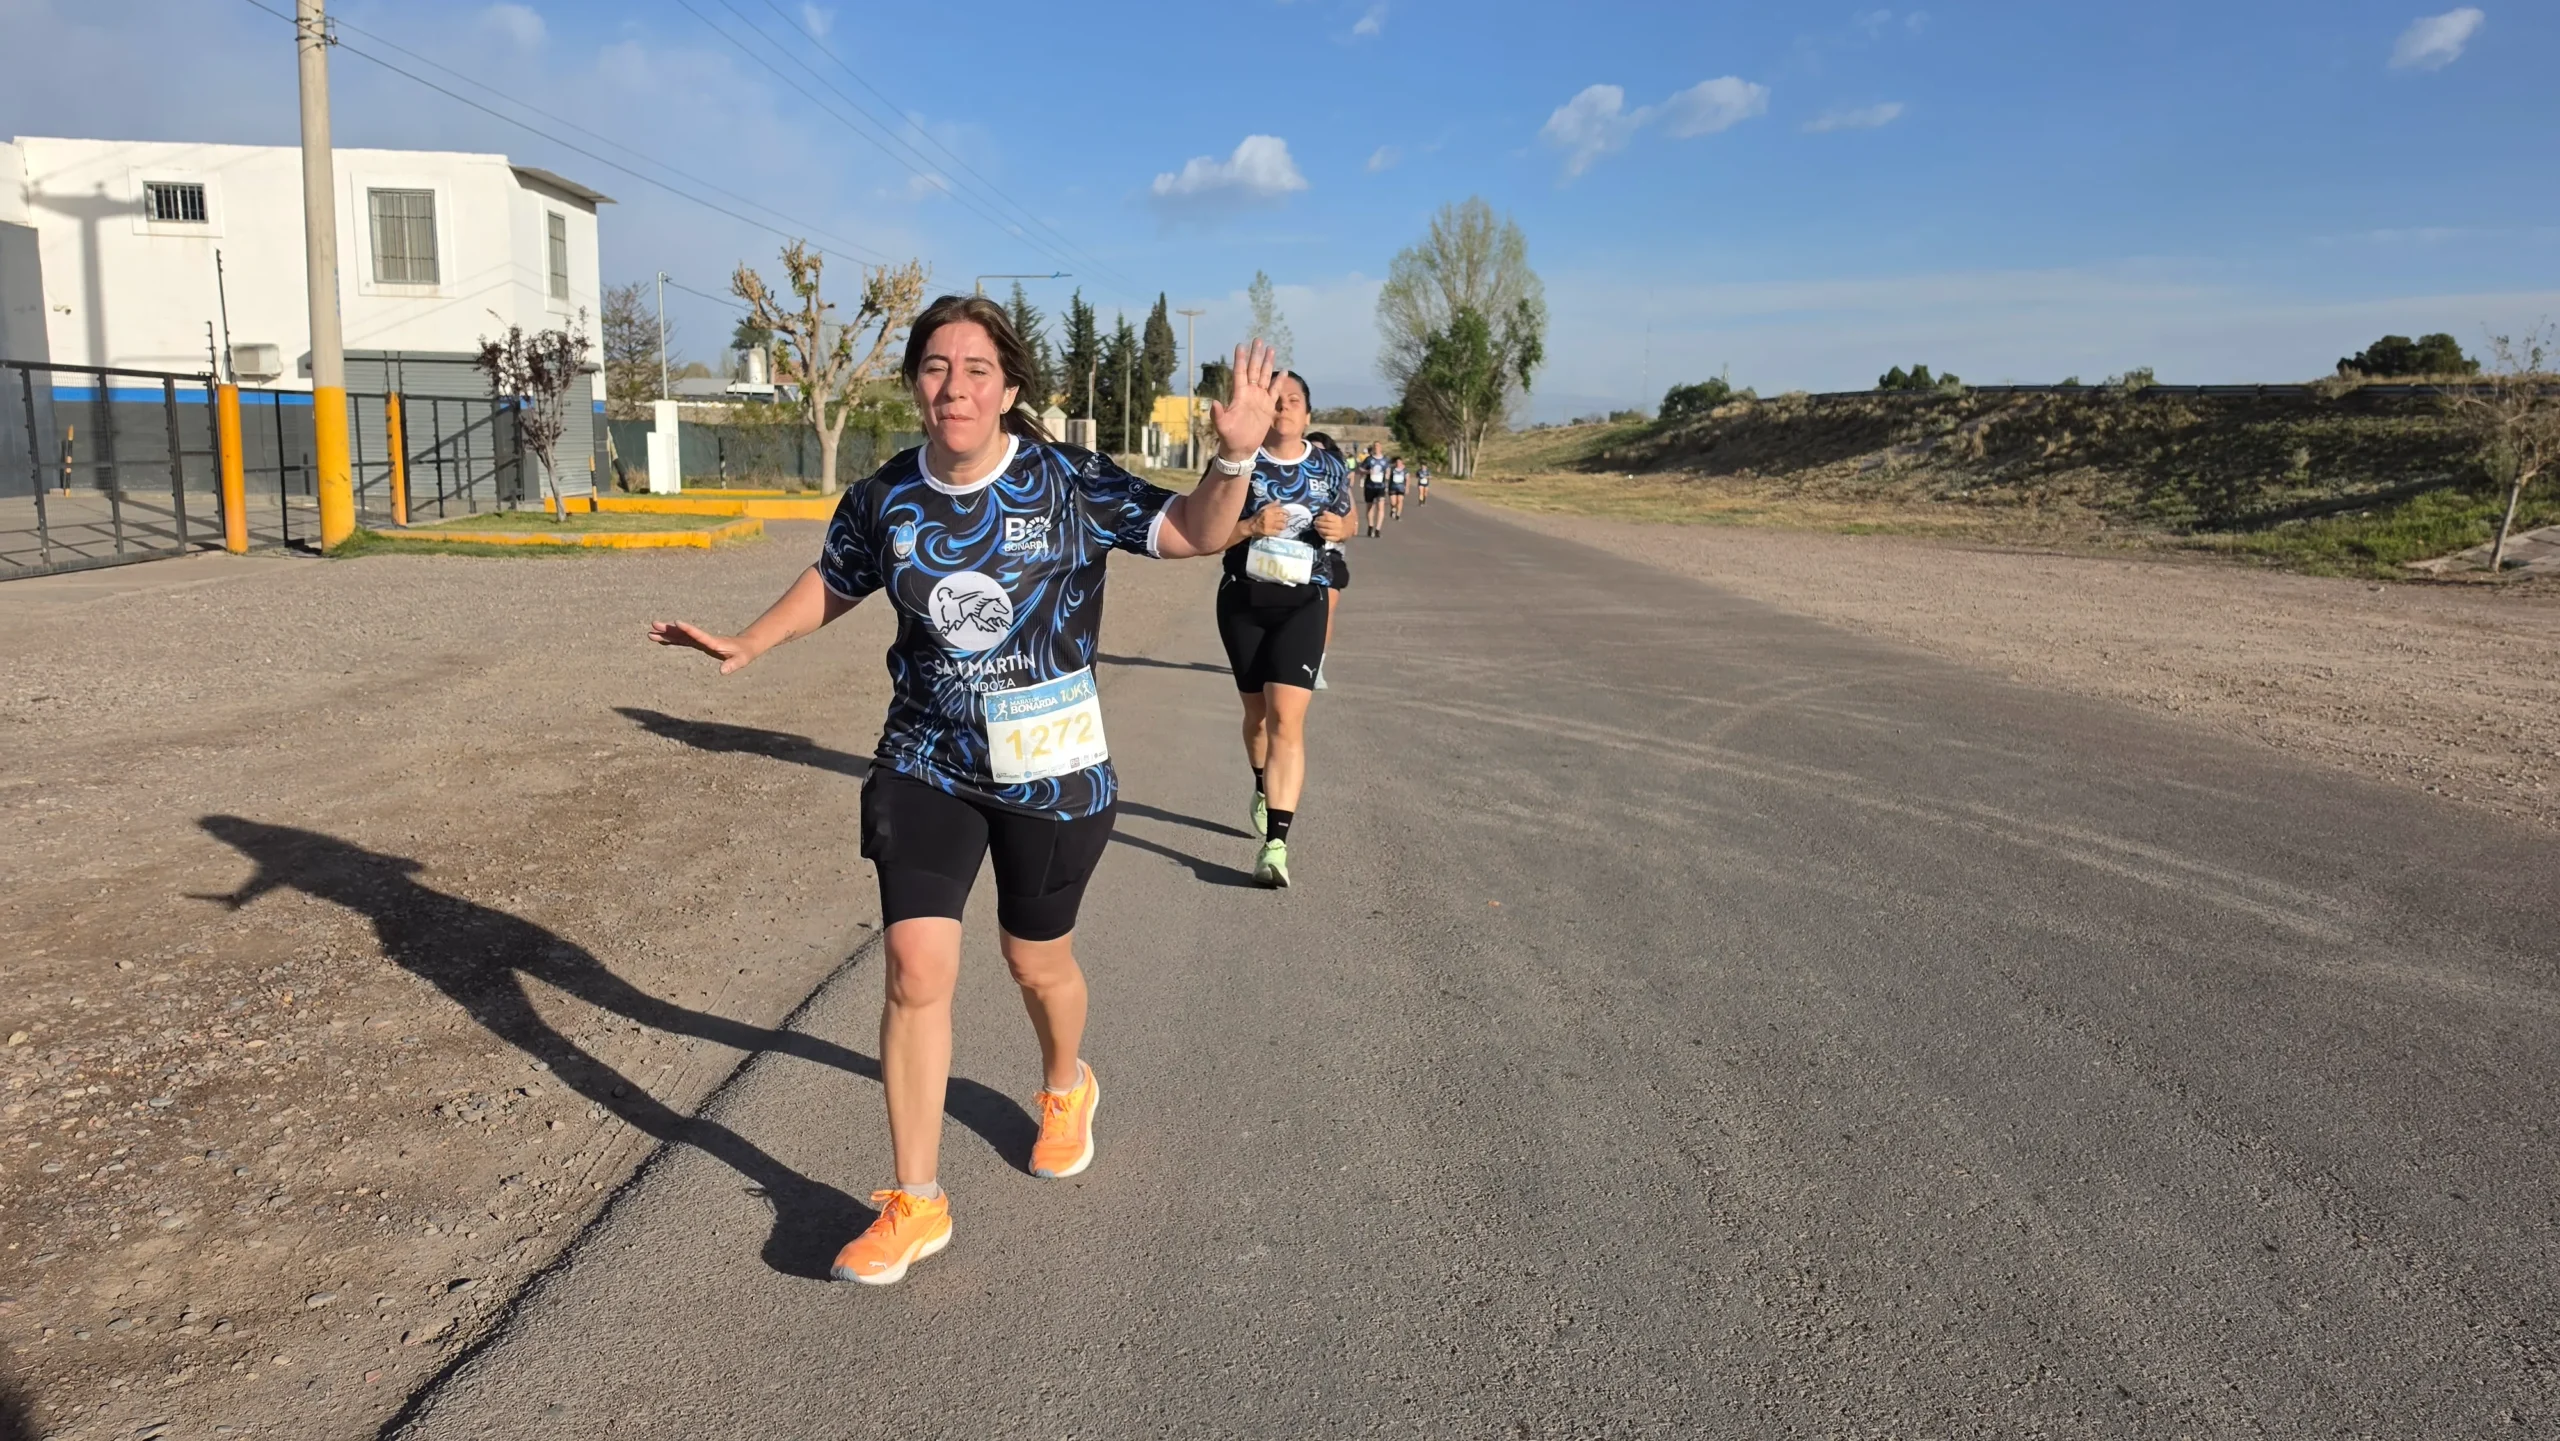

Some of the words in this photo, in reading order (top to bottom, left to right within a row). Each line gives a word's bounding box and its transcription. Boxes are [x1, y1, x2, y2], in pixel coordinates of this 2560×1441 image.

[1004, 540, 1049, 552] BONARDA
[967, 650, 1036, 677] MARTÍN
[955, 678, 1016, 692] MENDOZA
[1010, 697, 1059, 715] BONARDA
[1005, 711, 1096, 761] 1272
